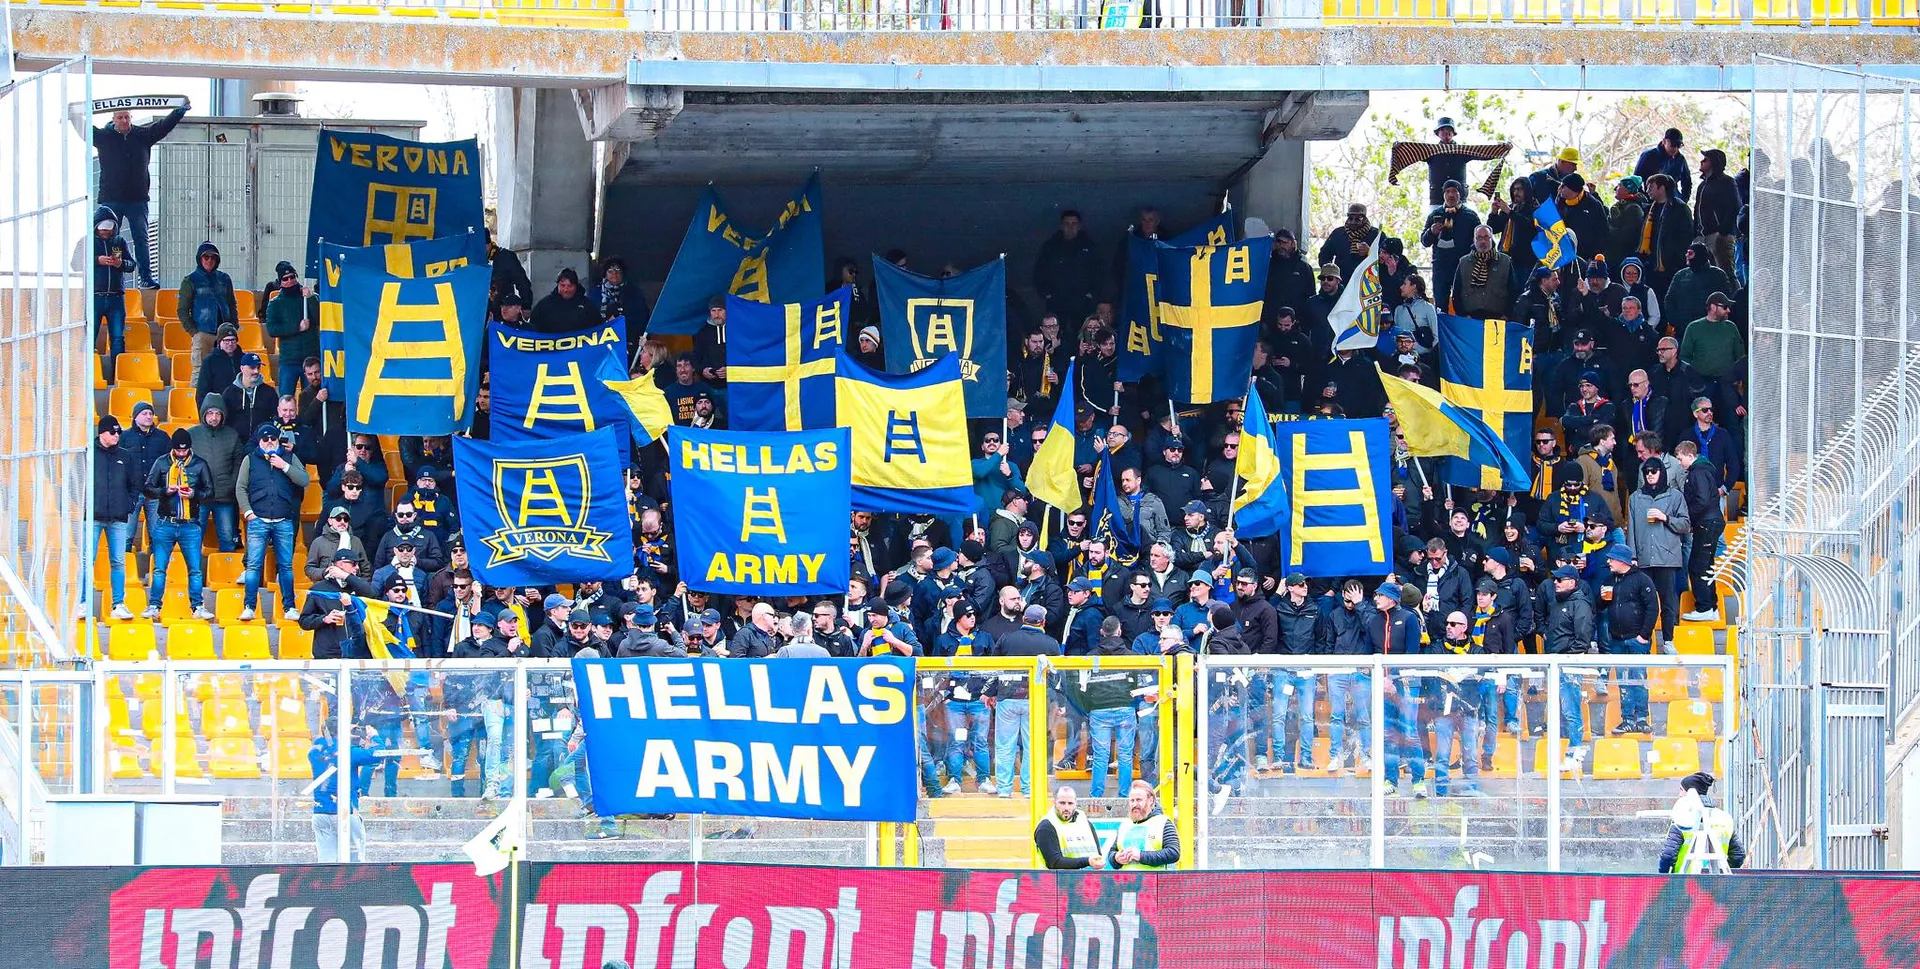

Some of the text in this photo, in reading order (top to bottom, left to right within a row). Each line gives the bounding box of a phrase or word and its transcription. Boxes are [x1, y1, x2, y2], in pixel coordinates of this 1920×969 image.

[92, 99, 131, 110] ELLAS
[330, 136, 469, 175] VERONA
[497, 327, 620, 351] VERONA
[682, 440, 838, 474] HELLAS
[513, 531, 578, 543] VERONA
[705, 552, 826, 584] ARMY
[586, 663, 906, 725] HELLAS
[635, 739, 876, 807] ARMY
[1183, 762, 1190, 774] 7
